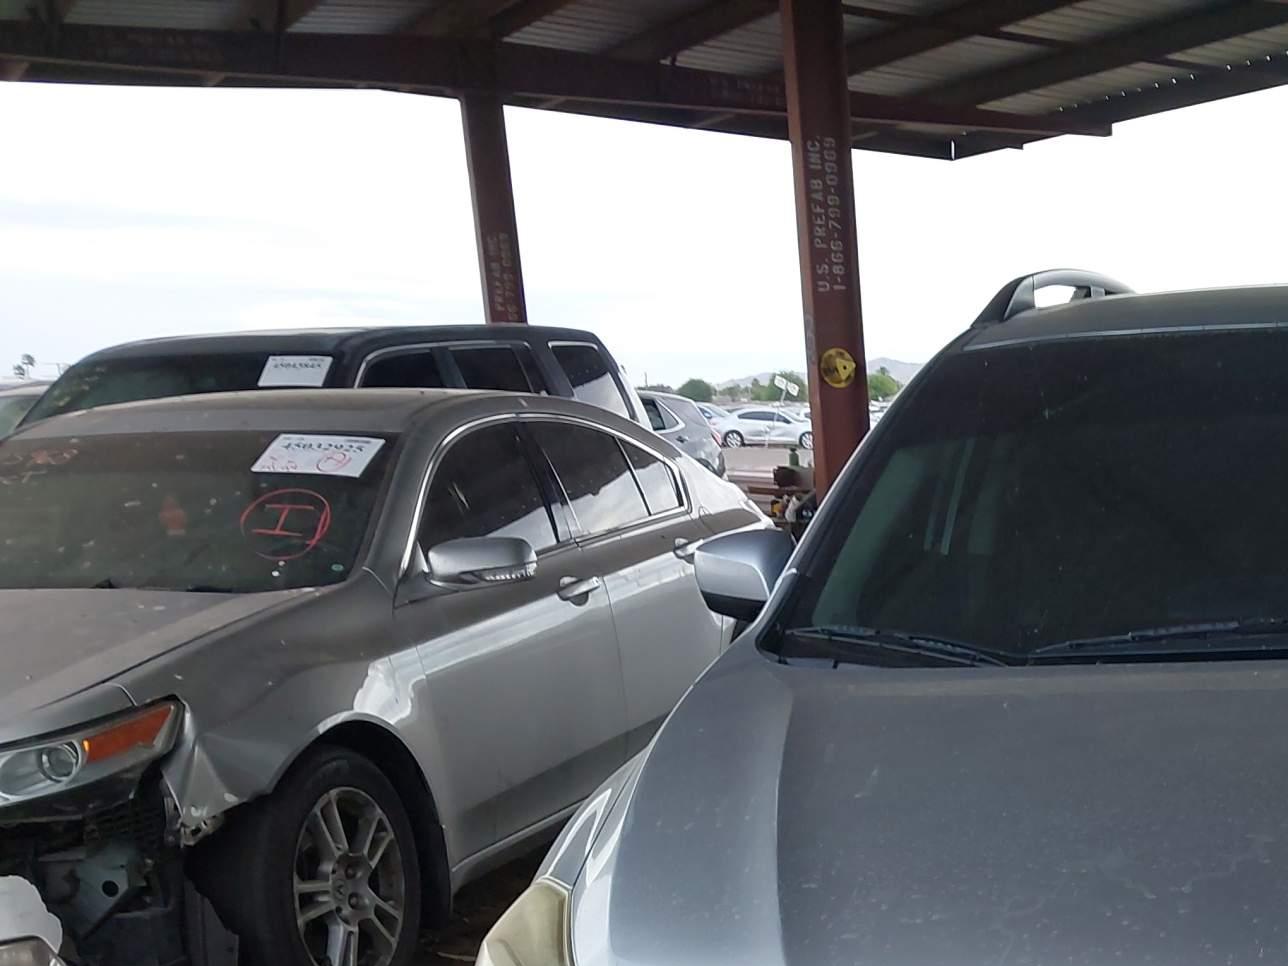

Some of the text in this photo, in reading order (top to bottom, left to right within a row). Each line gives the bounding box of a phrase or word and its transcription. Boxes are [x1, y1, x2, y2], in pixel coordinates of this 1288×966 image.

[807, 134, 831, 293] U.S. PREFAB INC.
